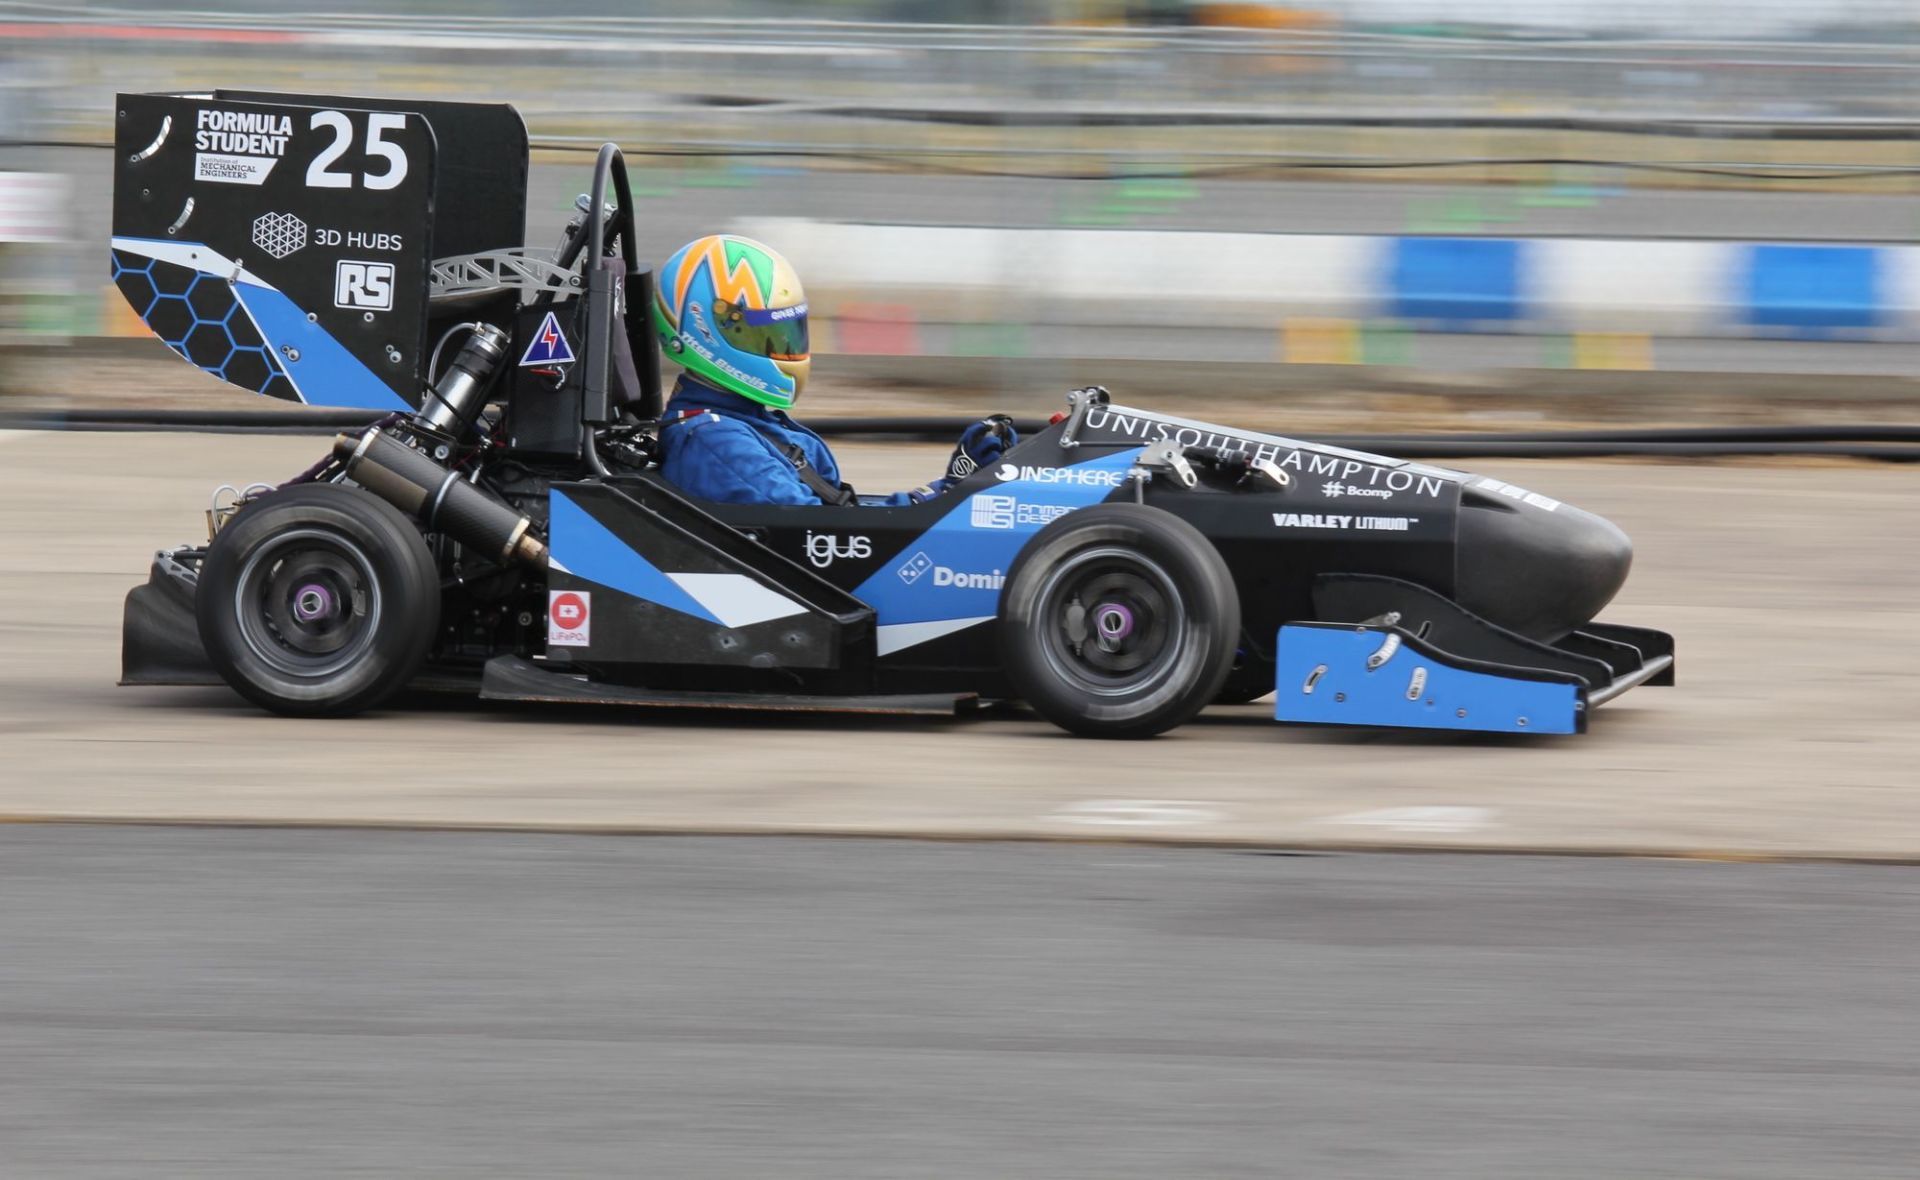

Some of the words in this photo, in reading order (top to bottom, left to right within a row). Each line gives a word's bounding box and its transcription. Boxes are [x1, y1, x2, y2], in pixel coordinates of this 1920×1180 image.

[197, 109, 293, 136] FORMULA
[195, 130, 289, 156] STUDENT
[306, 110, 408, 190] 25
[200, 162, 256, 173] MECHANICAL
[200, 169, 247, 179] ENGINEERS
[314, 229, 342, 246] 3D
[347, 231, 403, 251] HUBS
[337, 262, 392, 308] RS
[1020, 466, 1123, 487] INSPHERE
[1272, 513, 1353, 529] VARLEY
[804, 530, 873, 568] igus
